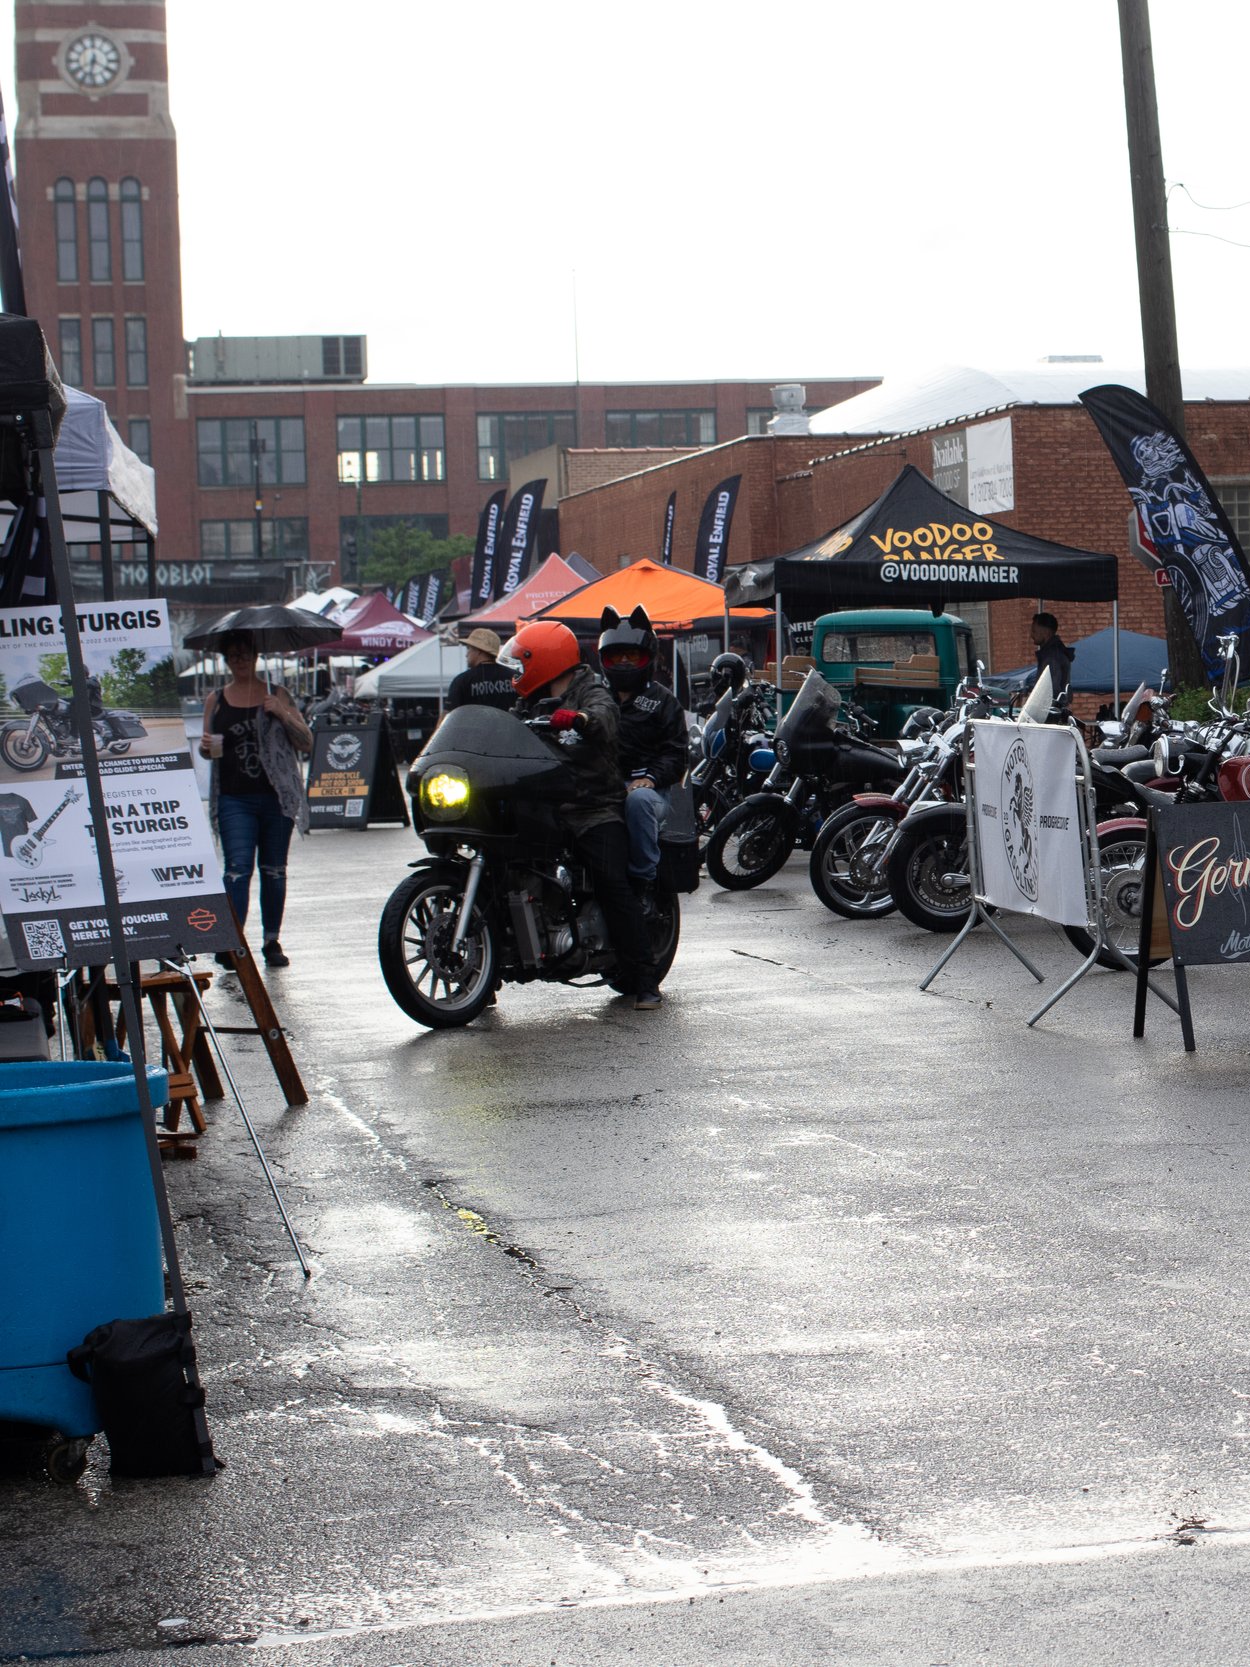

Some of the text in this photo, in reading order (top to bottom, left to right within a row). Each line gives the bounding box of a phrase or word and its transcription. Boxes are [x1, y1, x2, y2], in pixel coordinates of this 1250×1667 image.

[493, 493, 534, 593] ROYAL ENFIELD
[705, 491, 730, 583] OYAL ENFIELD
[870, 522, 993, 553] VOODOO
[479, 503, 499, 599] ROYAL ENFIELD
[120, 563, 214, 587] MOOBLOT
[880, 561, 1019, 584] @VOODOORANGER
[361, 636, 412, 648] WINDY CIT
[634, 695, 661, 711] DIRTY
[104, 759, 131, 767] CHANCE
[138, 763, 166, 772] SPECIAL
[127, 803, 140, 817] A
[141, 800, 180, 816] TRIP
[311, 805, 326, 813] VOTE
[112, 816, 189, 836] STURGIS
[151, 863, 204, 882] VFW
[69, 919, 90, 931] GET
[90, 917, 109, 929] YOU
[72, 930, 98, 942] HERE
[99, 926, 138, 939] TOAY.
